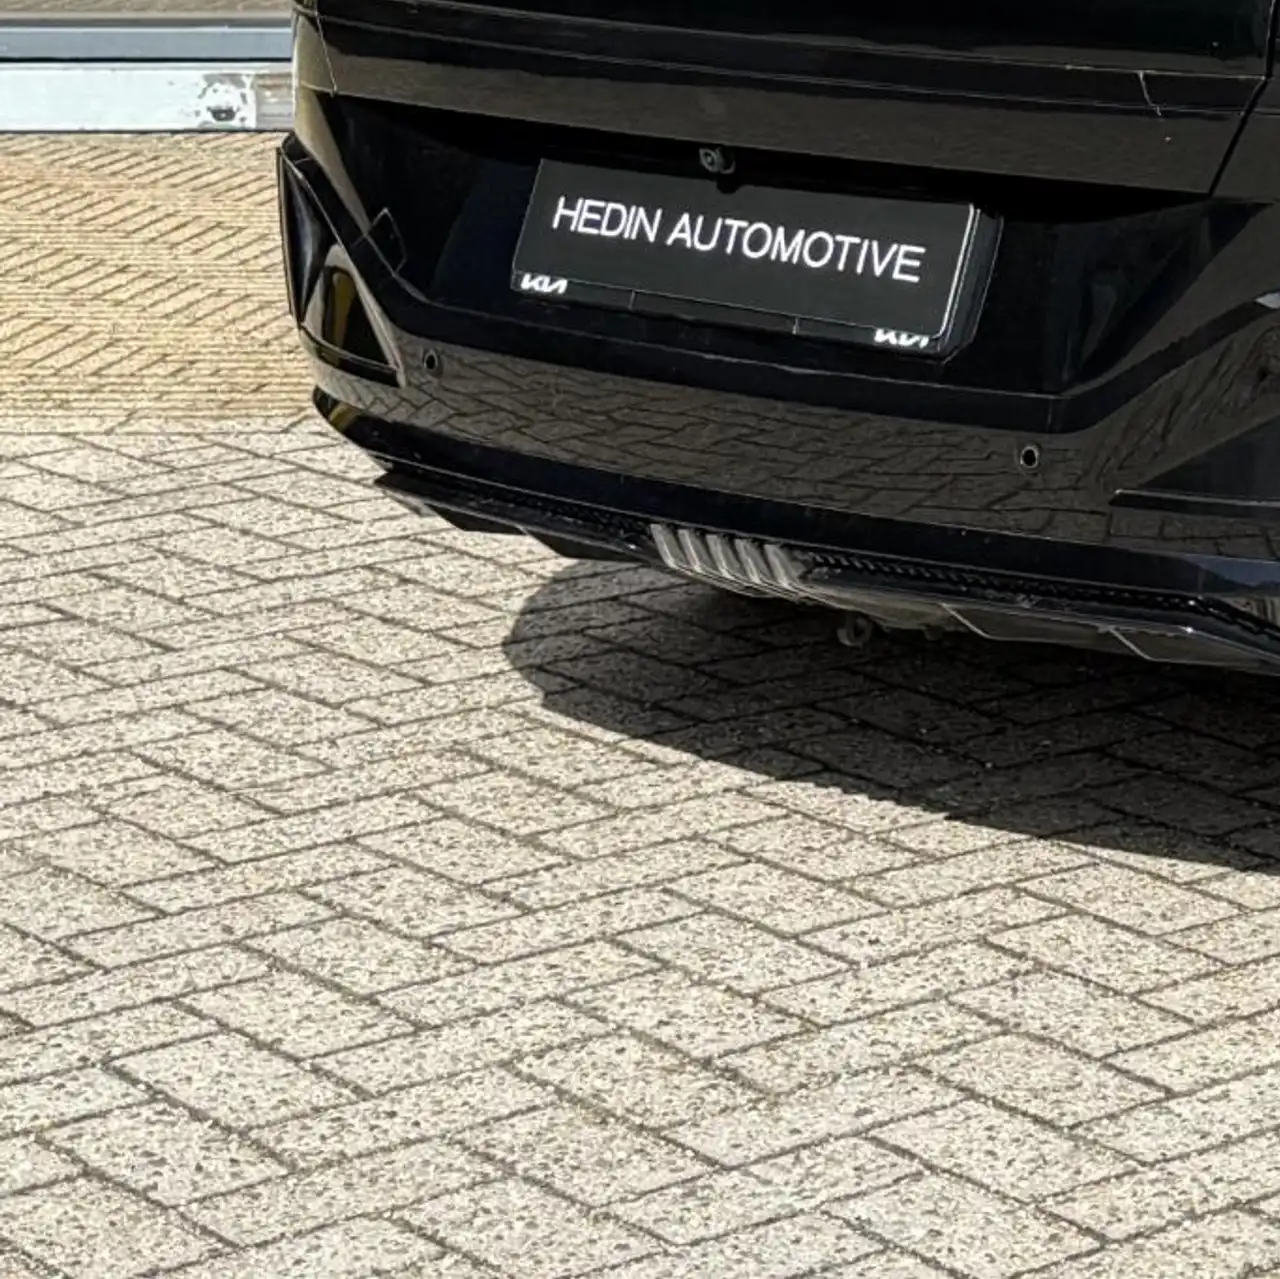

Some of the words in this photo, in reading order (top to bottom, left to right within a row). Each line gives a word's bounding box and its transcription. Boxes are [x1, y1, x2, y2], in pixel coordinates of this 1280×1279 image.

[551, 195, 662, 244] HEDIN
[666, 213, 926, 284] AUTOMOTIVE
[520, 272, 568, 294] KIA
